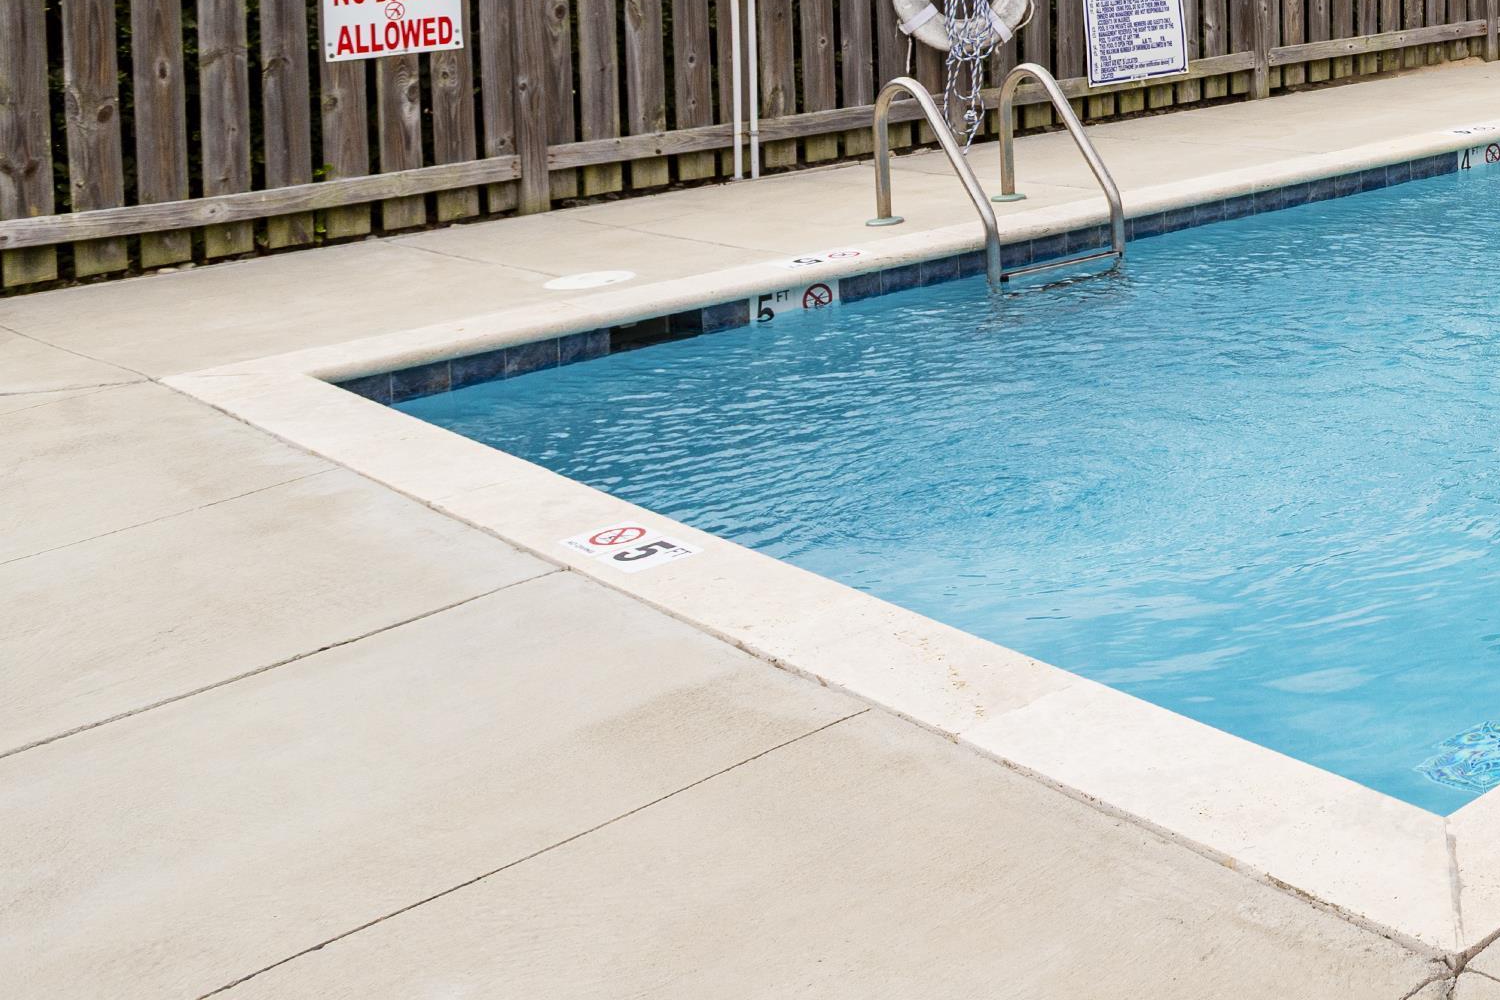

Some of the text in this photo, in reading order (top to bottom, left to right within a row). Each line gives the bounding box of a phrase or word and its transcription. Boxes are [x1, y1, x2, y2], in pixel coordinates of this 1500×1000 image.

[336, 16, 453, 56] ALLOWED
[1461, 148, 1471, 169] 4
[758, 290, 790, 322] 5 FT
[613, 540, 676, 562] 5
